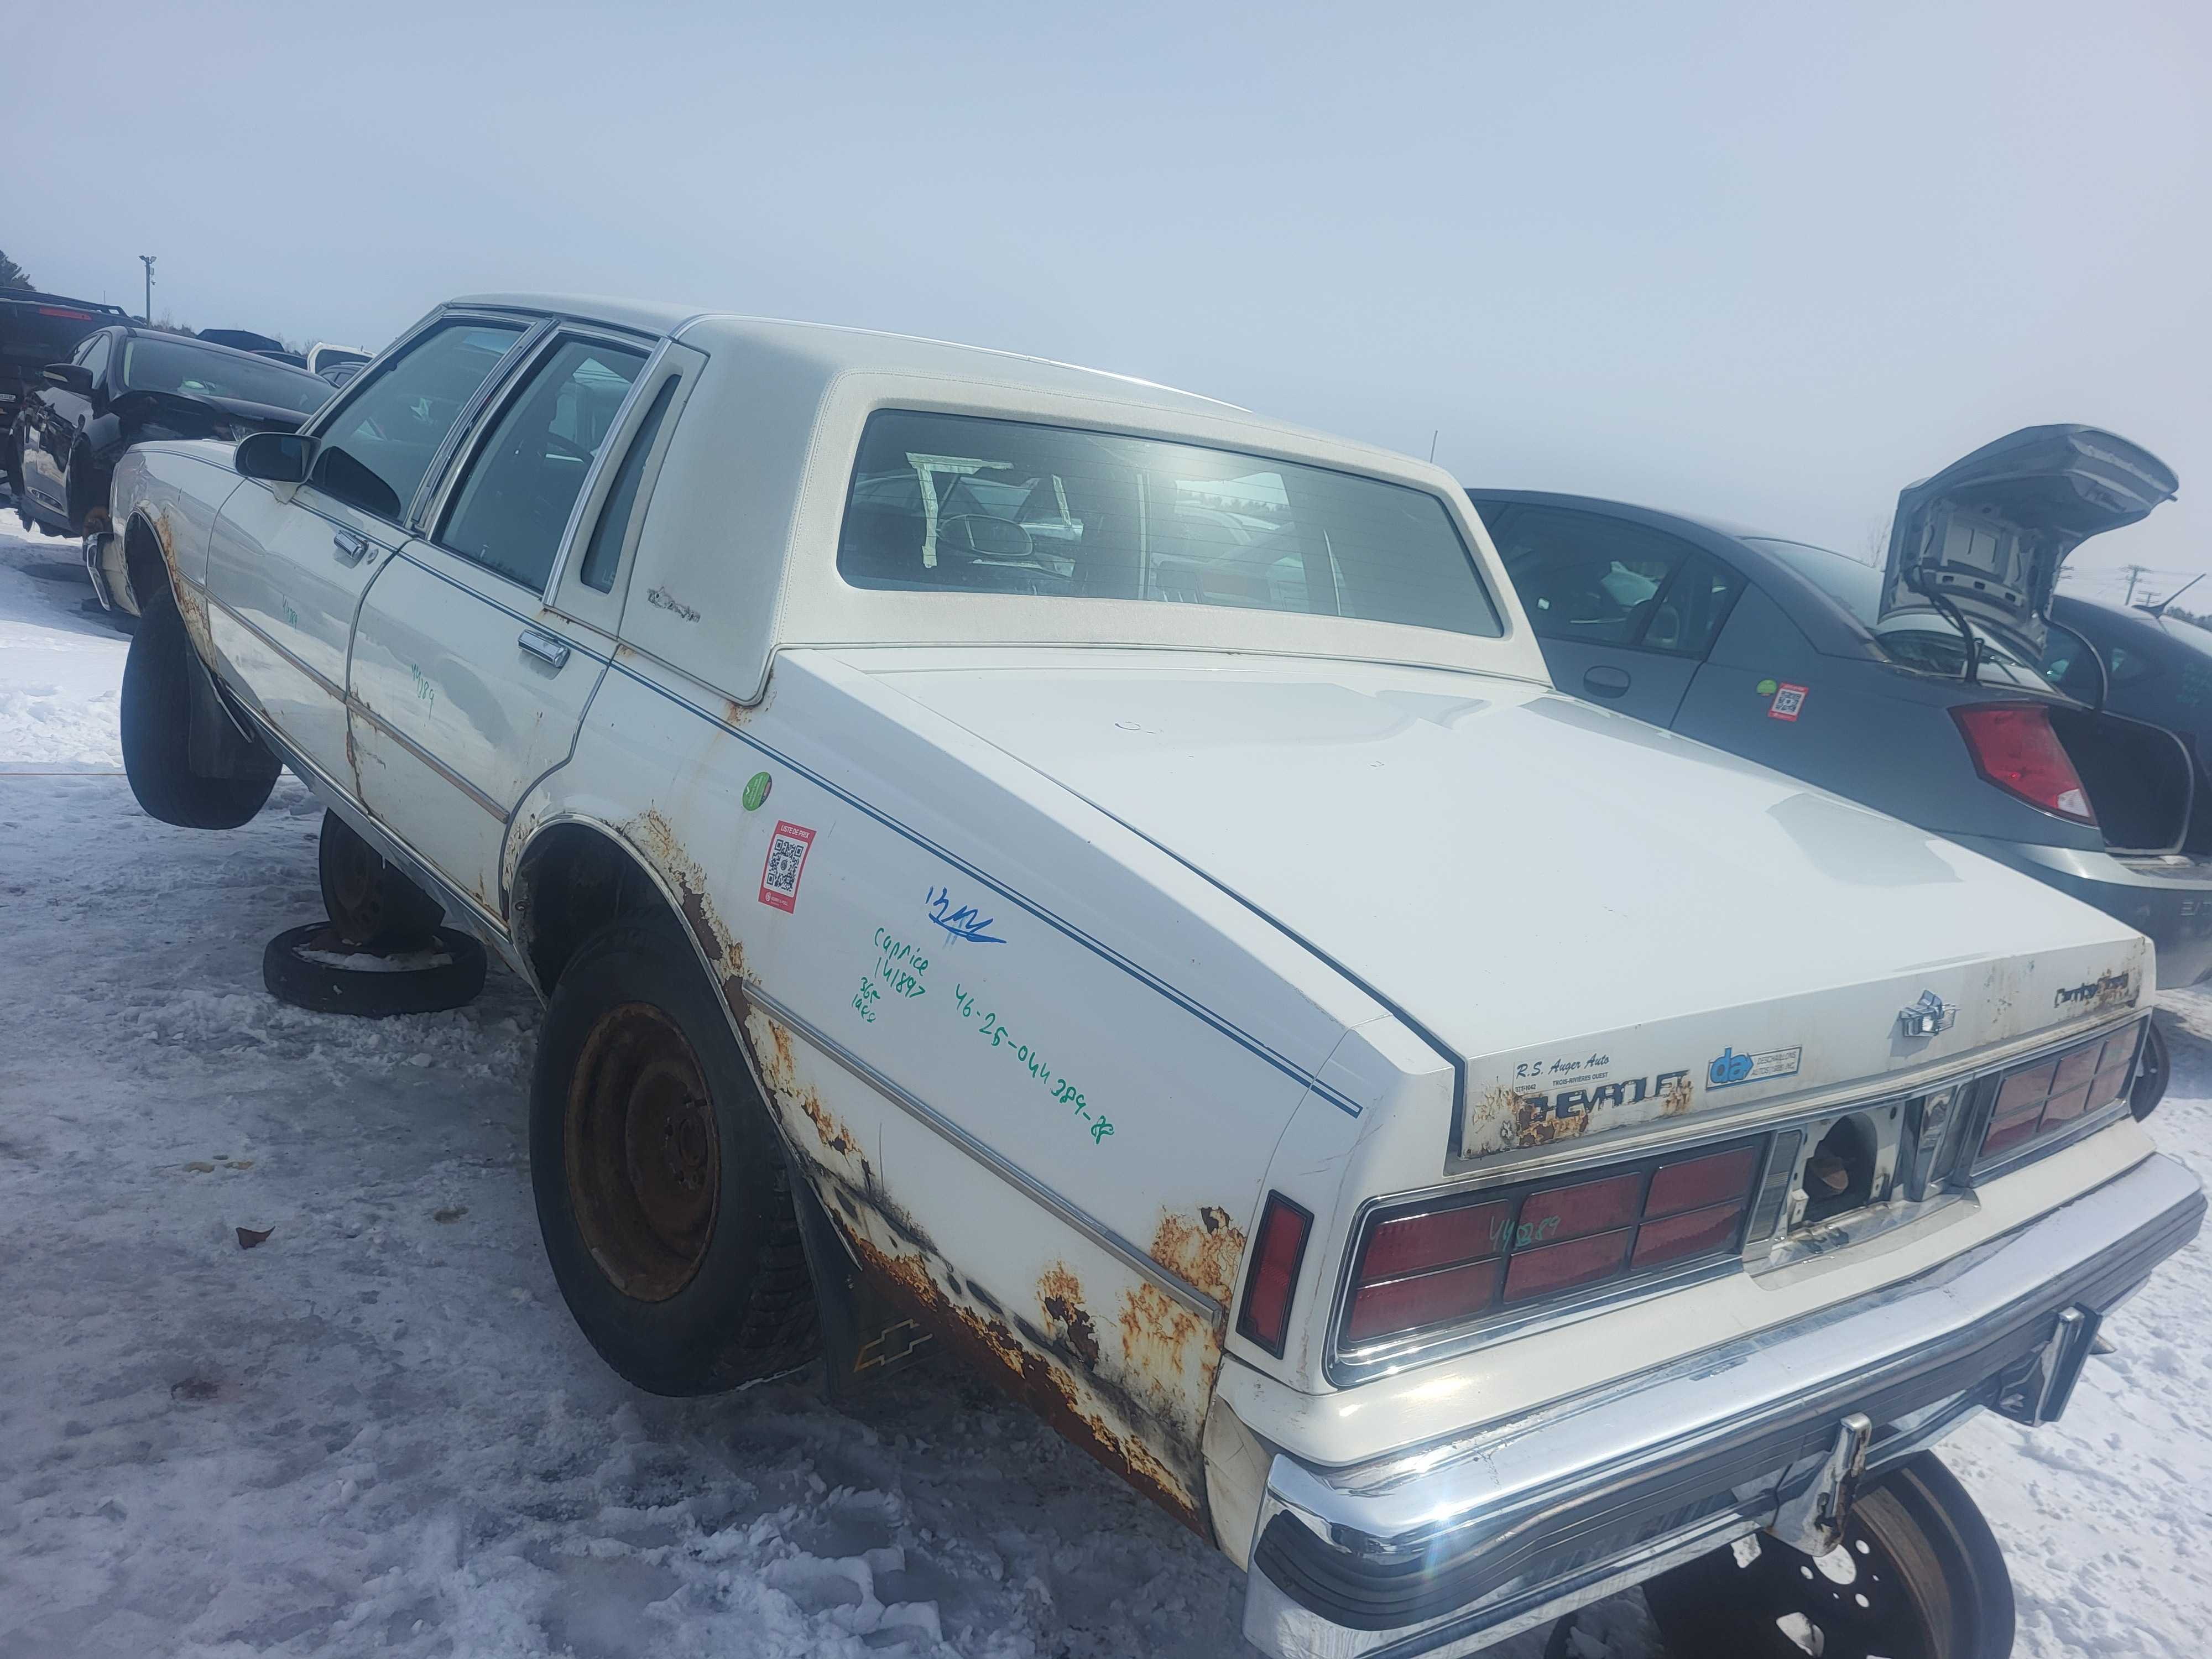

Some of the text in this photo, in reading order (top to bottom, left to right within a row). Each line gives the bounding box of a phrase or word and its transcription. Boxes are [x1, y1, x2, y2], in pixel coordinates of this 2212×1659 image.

[780, 824, 793, 834] LISTE
[798, 830, 810, 839] PRIX
[1516, 1052, 1610, 1079] R.S. Auger Auto
